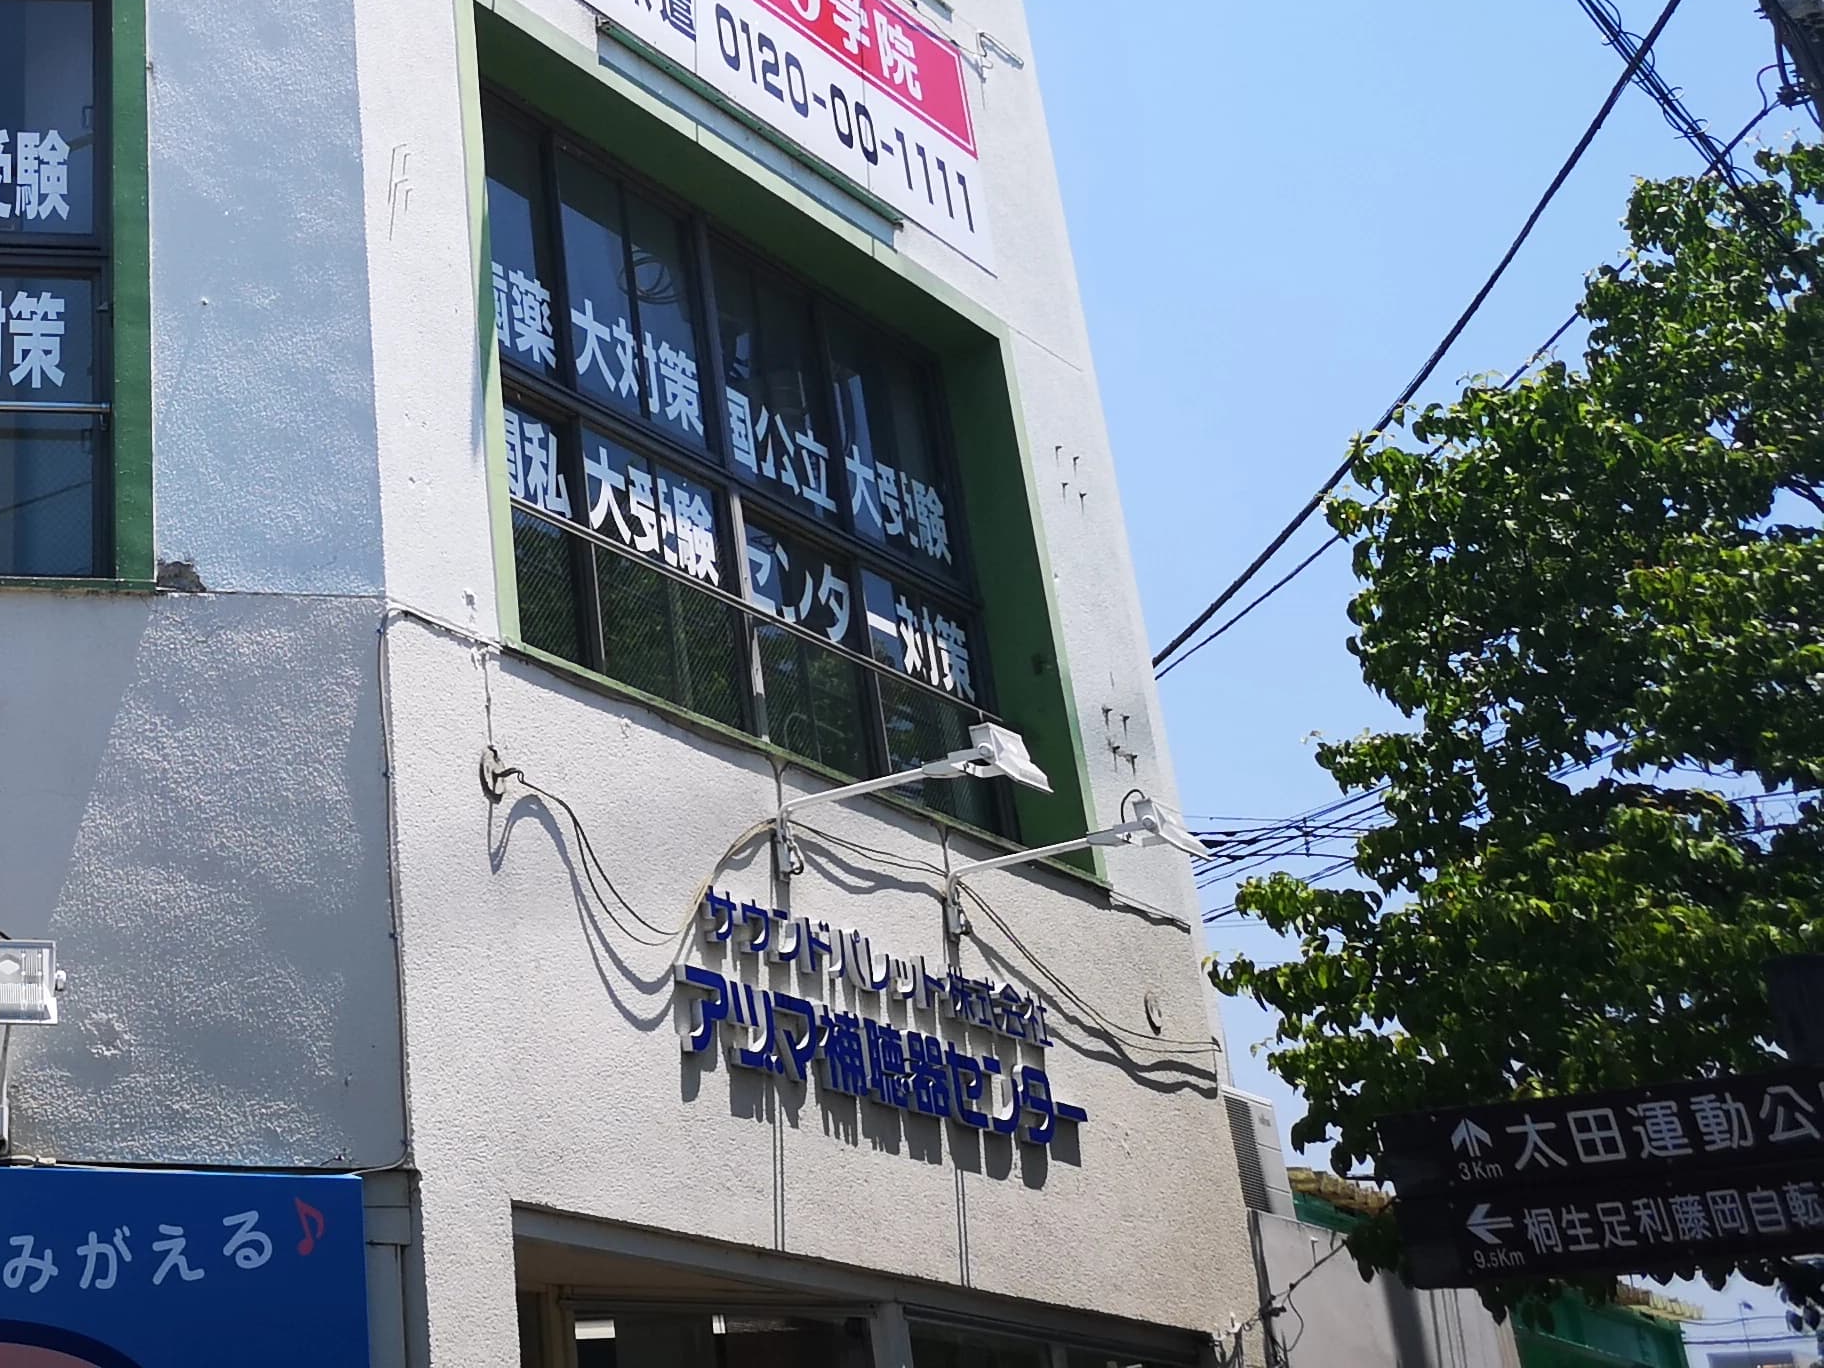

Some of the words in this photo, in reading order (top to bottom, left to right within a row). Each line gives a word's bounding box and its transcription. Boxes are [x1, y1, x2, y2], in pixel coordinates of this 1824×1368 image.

[715, 2, 976, 234] 0120-00-1111
[1505, 1082, 1824, 1172] 太田運動公
[1522, 1179, 1824, 1255] 桐生足利藤岡自転
